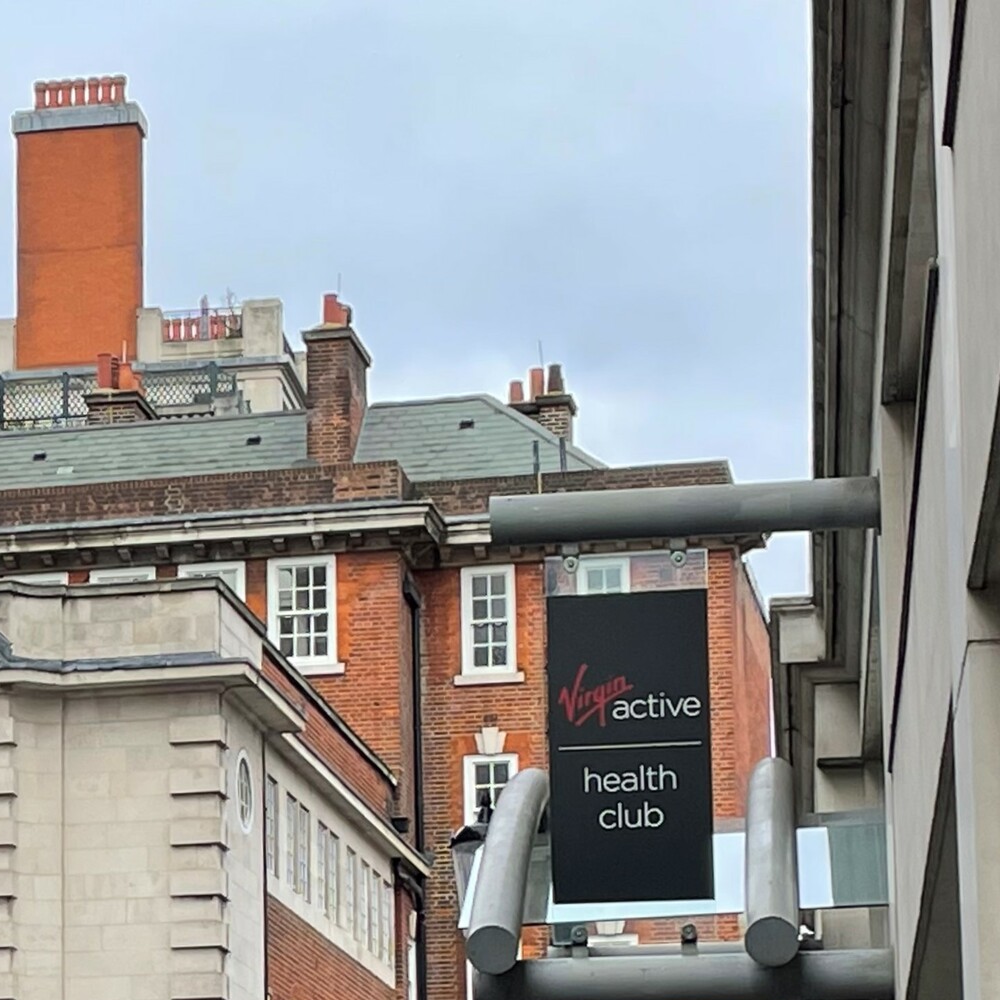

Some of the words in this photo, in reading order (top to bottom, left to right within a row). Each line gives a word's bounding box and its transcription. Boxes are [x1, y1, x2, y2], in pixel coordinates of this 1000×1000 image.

[558, 663, 634, 727] Virgin
[612, 691, 702, 720] active
[583, 764, 678, 793] health
[599, 801, 665, 829] club
